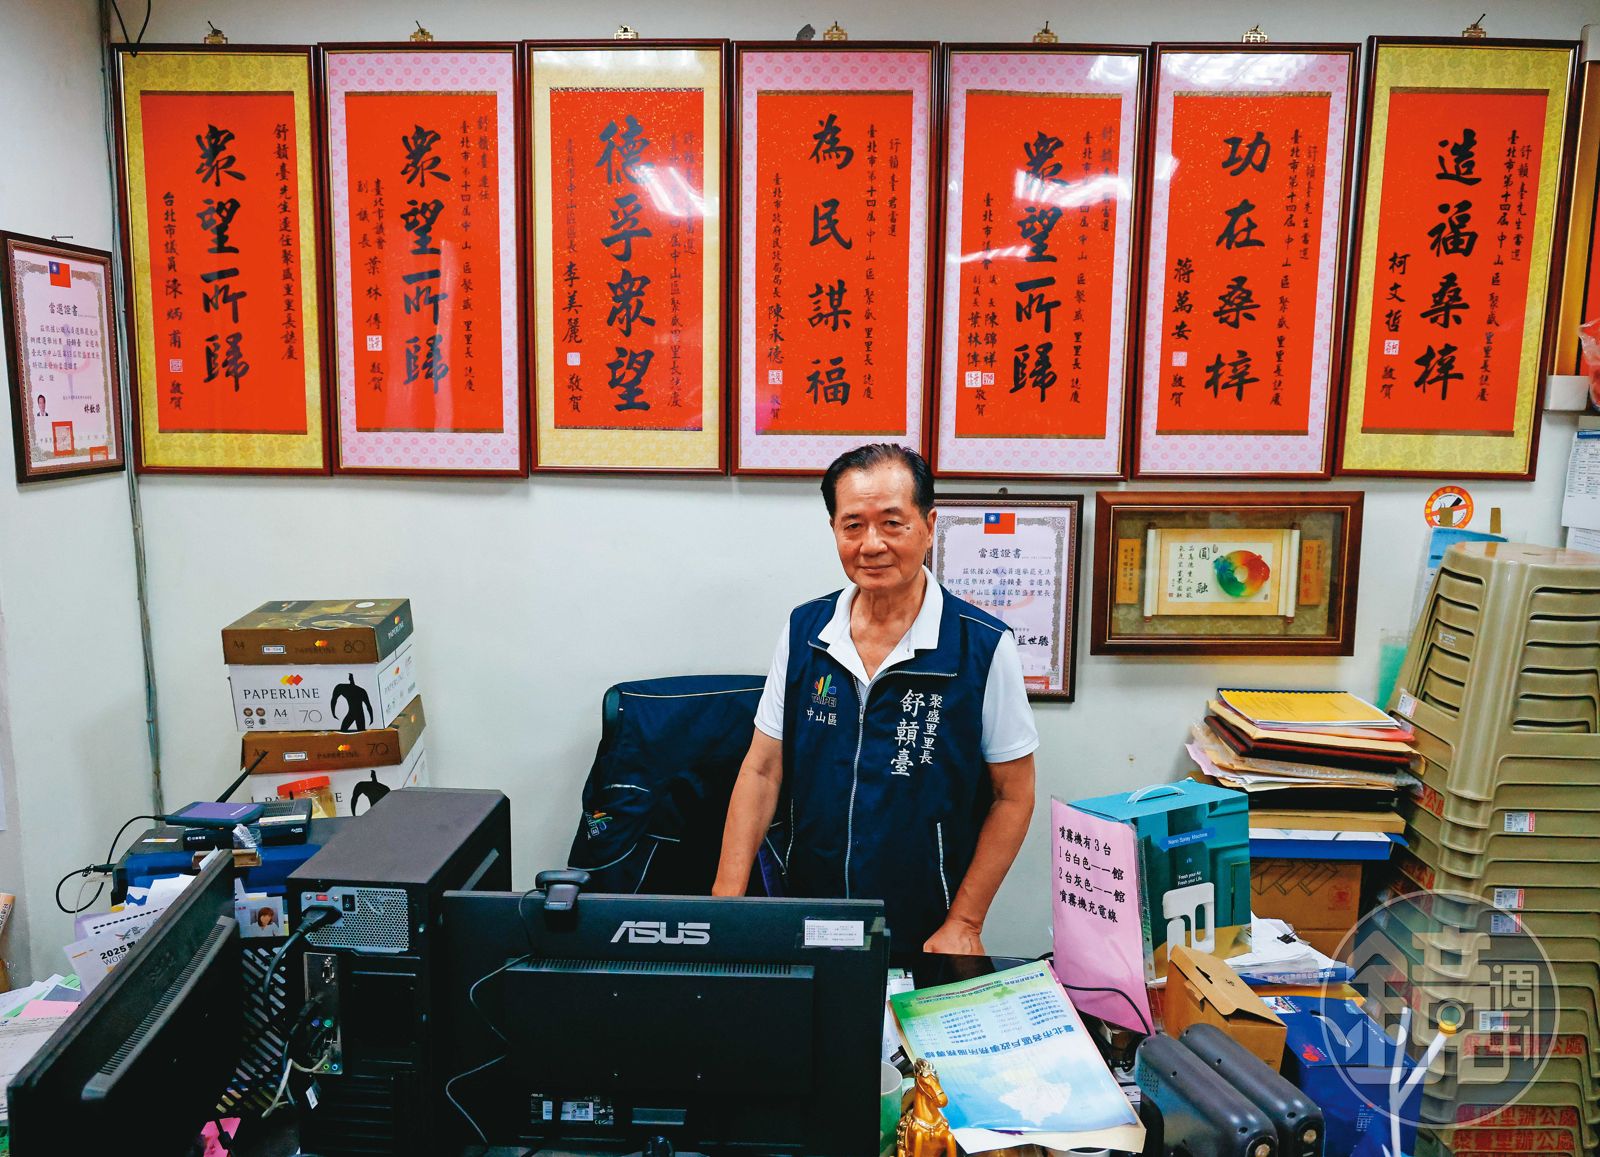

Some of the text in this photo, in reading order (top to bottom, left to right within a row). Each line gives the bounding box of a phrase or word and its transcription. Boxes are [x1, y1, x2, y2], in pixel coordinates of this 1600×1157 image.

[806, 113, 855, 406] 為民謀福
[1203, 131, 1270, 403] 功在桑梓
[1413, 128, 1483, 402] 造福桑梓
[1171, 257, 1195, 341] 蔣萬安
[1385, 252, 1411, 333] 柯文哲
[48, 302, 79, 318] 當選證書
[978, 546, 1023, 560] 當選證書
[344, 639, 367, 654] 80
[243, 688, 320, 700] PAPERLINE
[811, 692, 837, 708] TAIPEI
[274, 708, 288, 718] A4
[299, 709, 323, 724] 70
[806, 707, 838, 726] 中山區
[918, 693, 943, 765] 聚盛里里長
[367, 742, 390, 756] 70
[1059, 889, 1119, 924] 噴霧機充電線
[610, 921, 711, 945] ASUS
[100, 946, 127, 960] 2025
